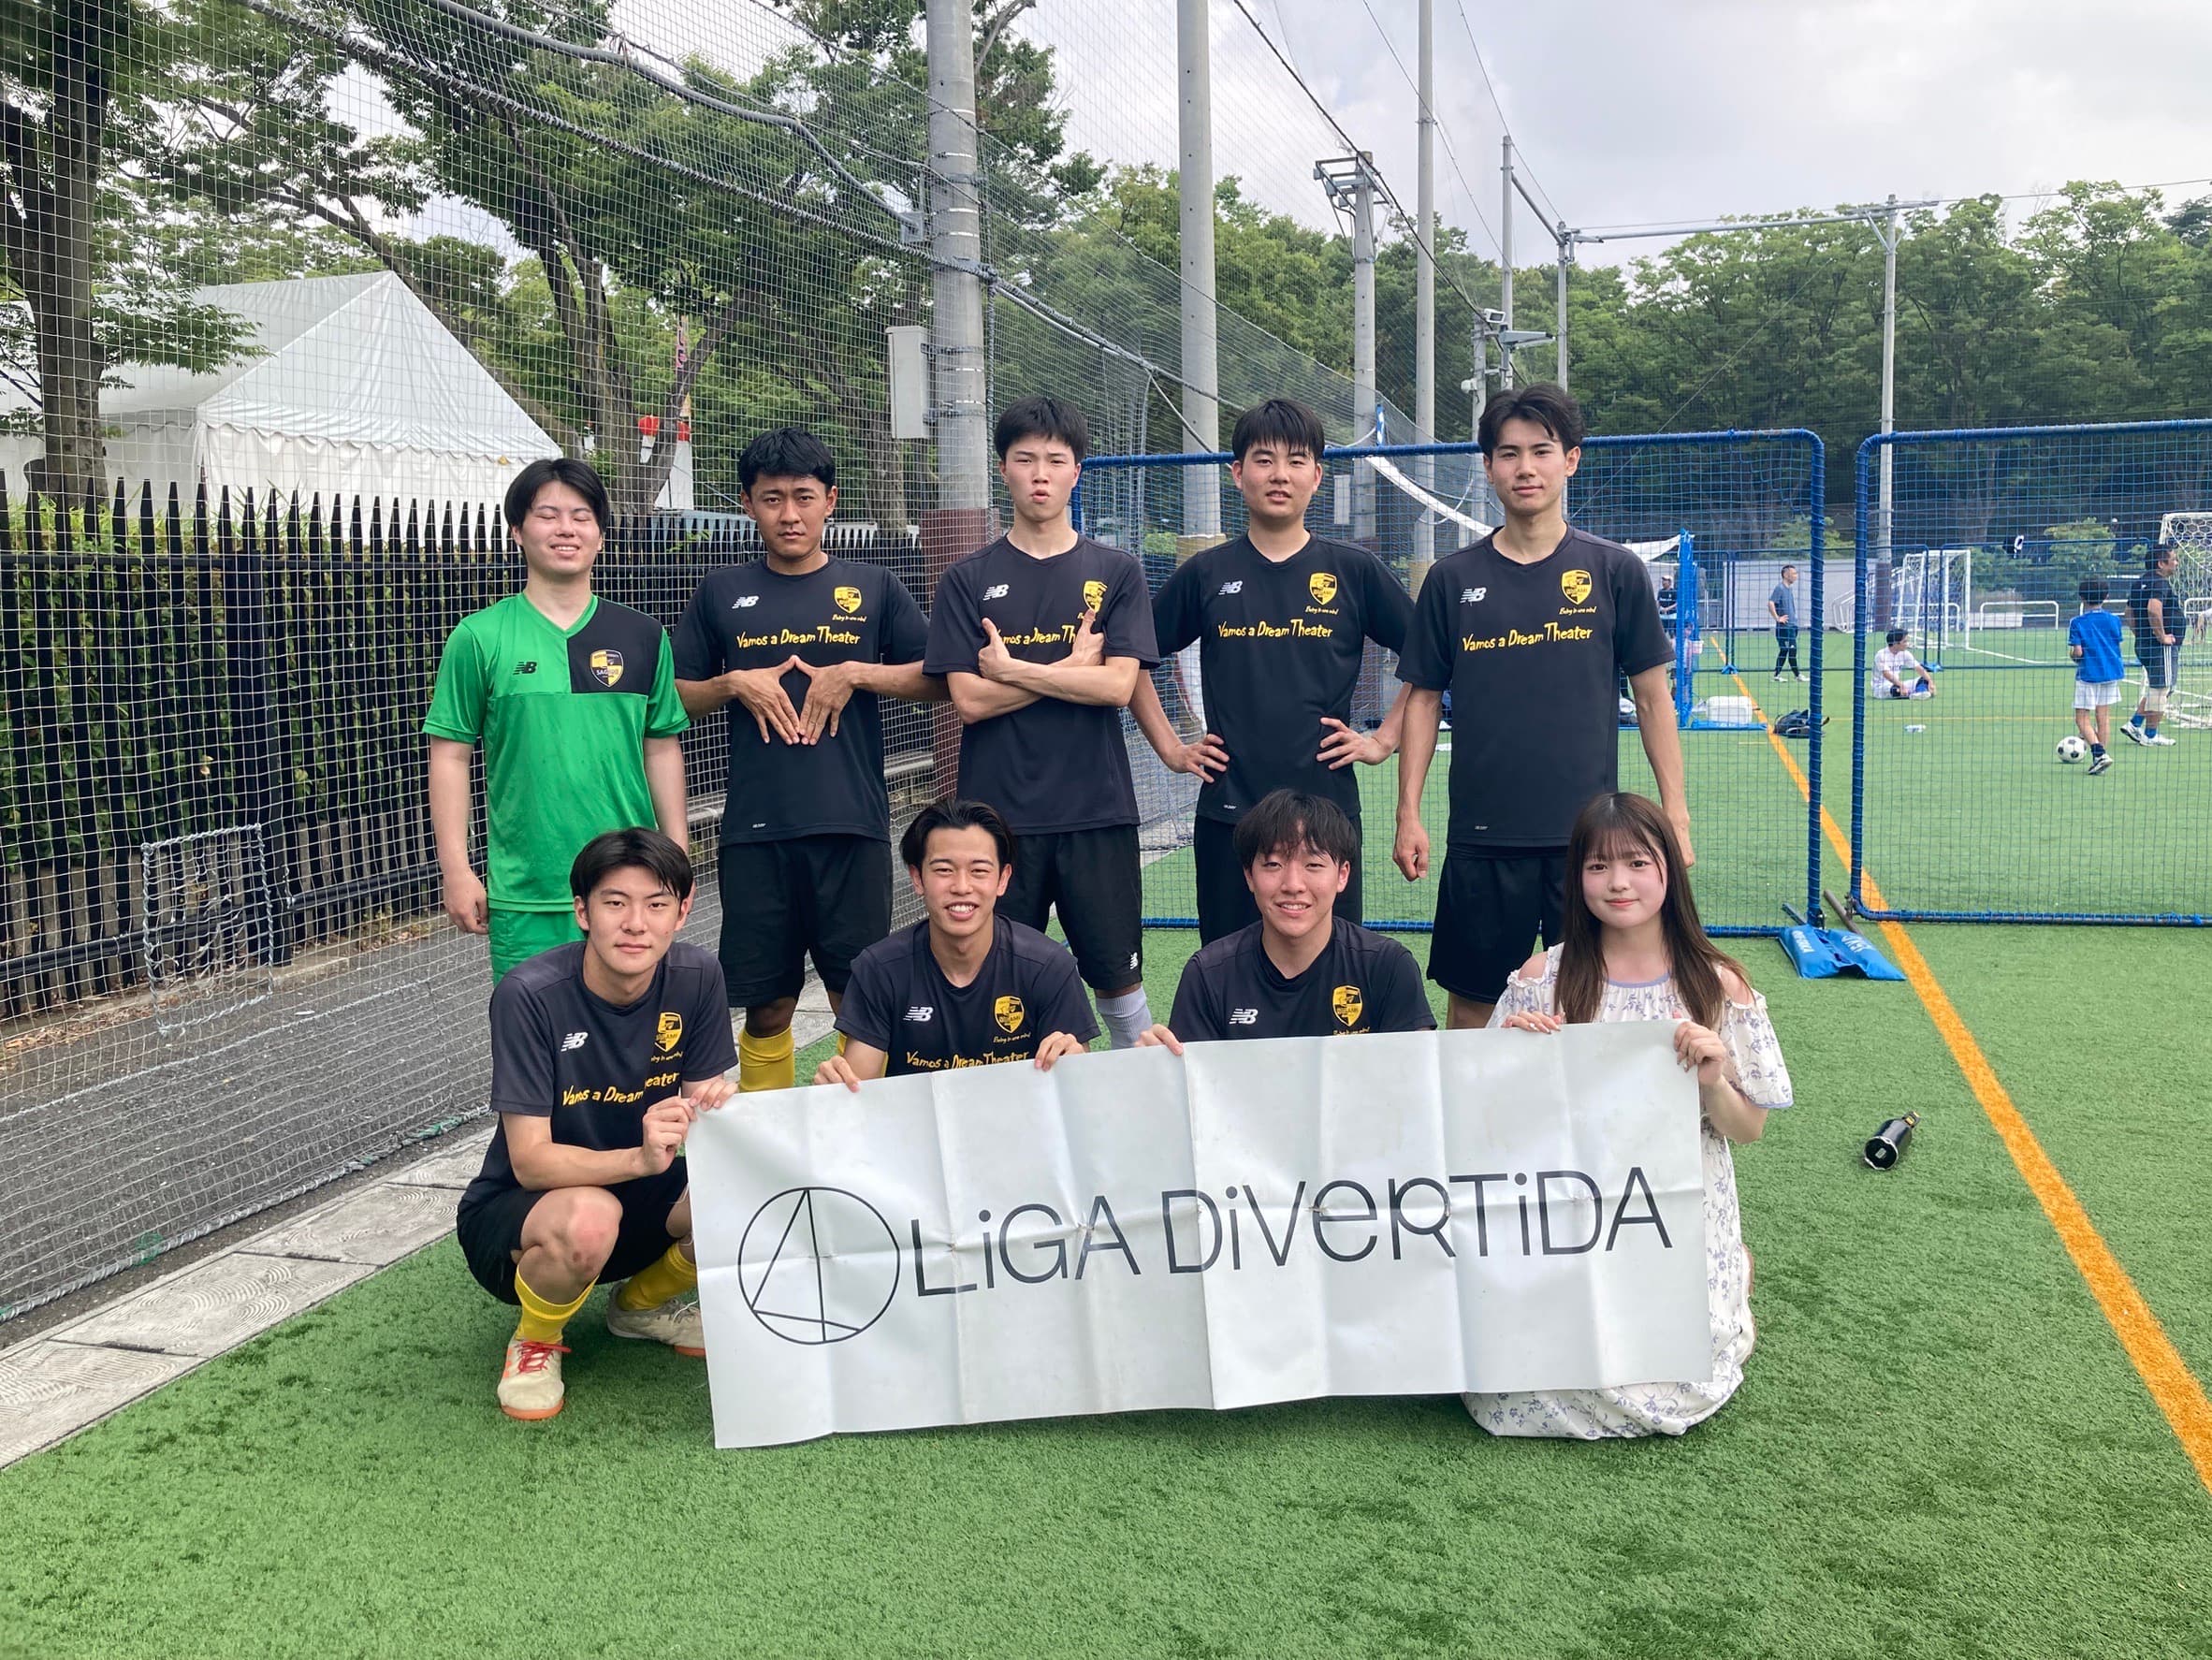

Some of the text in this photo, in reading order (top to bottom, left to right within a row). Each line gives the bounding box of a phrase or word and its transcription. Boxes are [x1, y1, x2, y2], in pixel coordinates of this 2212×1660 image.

[736, 626, 861, 648] Vamos a Dream Theater
[1024, 634, 1030, 644] a
[1218, 619, 1332, 637] Vamos a Dream Theater
[1463, 621, 1593, 651] Vamos a Dream Theater
[906, 1051, 941, 1069] Vamos
[943, 1060, 950, 1069] a
[591, 1091, 602, 1100] a
[604, 1085, 644, 1103] Dream
[644, 1071, 680, 1088] eater
[911, 1194, 1142, 1299] LiGA
